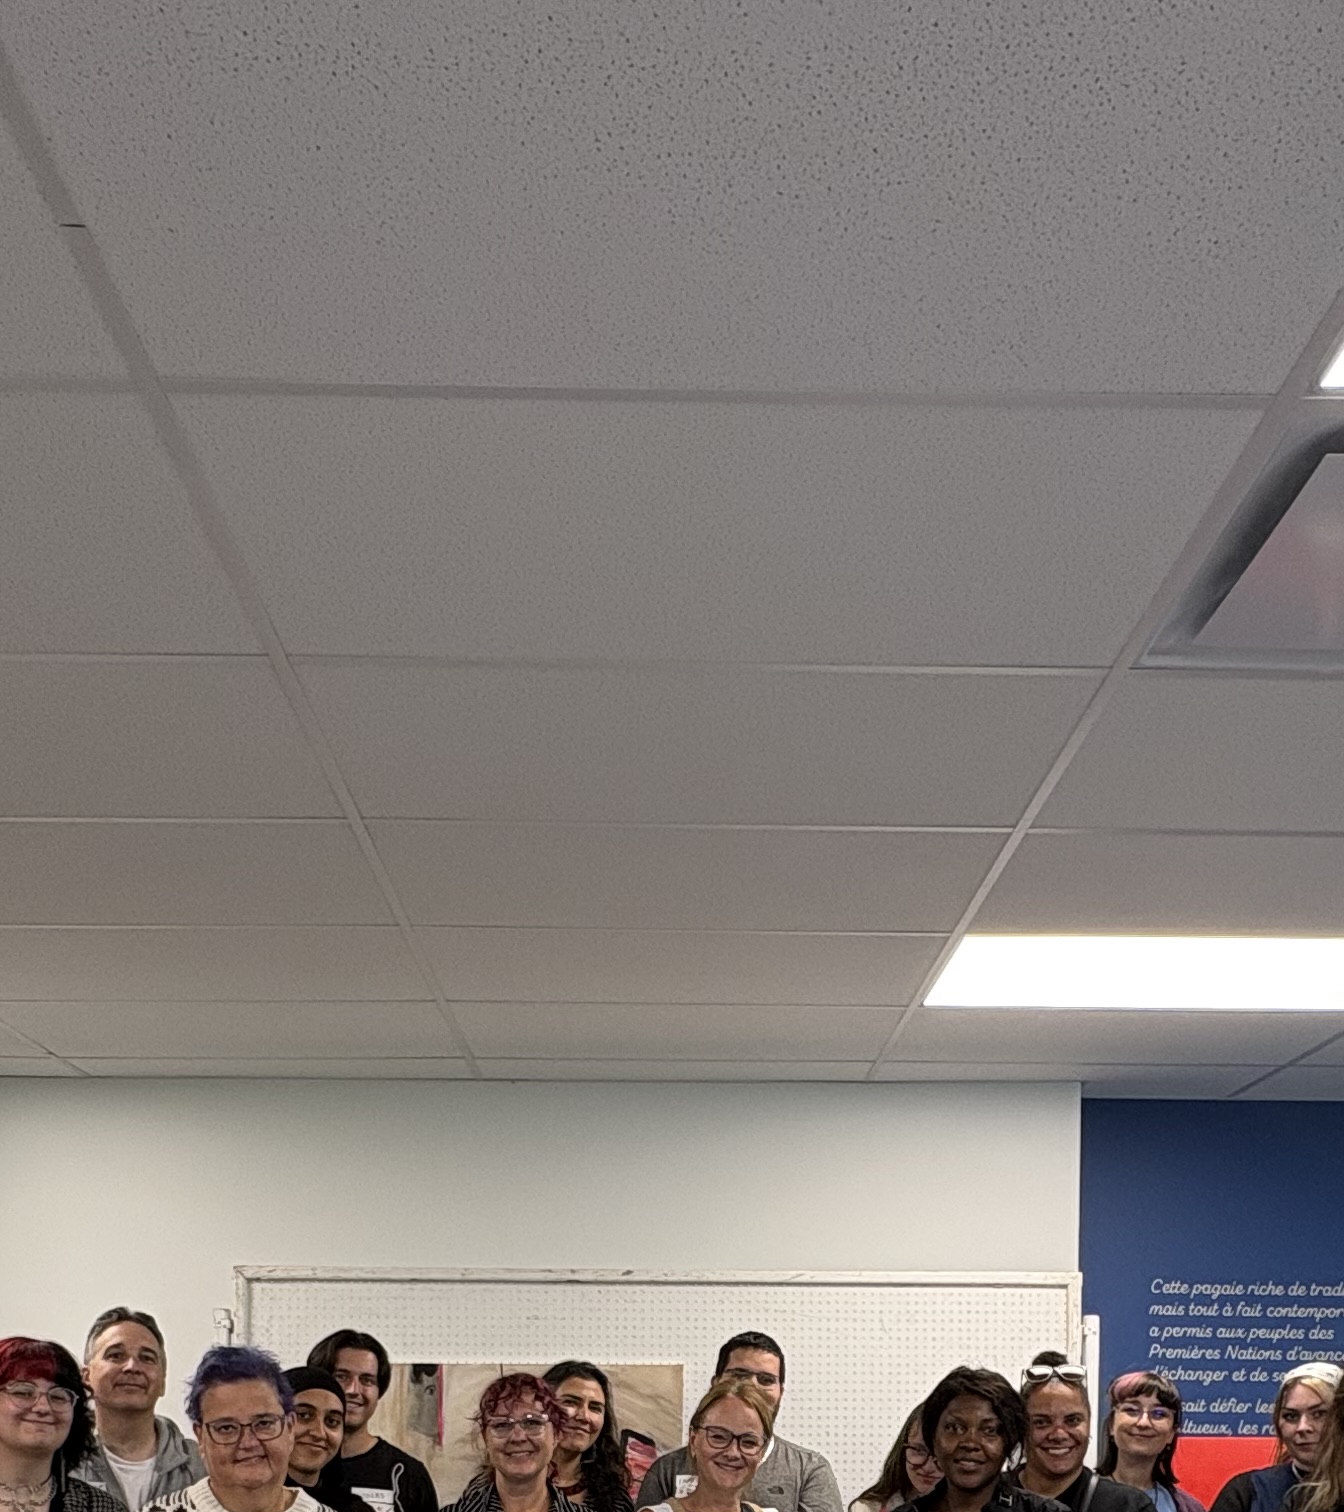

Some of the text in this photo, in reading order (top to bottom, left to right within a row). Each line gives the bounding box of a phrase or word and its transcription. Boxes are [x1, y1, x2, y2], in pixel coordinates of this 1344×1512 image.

[1150, 1278, 1190, 1294] Cette
[1191, 1281, 1246, 1299] pagaie
[1247, 1282, 1286, 1296] riche
[1288, 1282, 1306, 1296] de
[1148, 1302, 1185, 1316] mais
[1189, 1303, 1220, 1317] tout
[1222, 1302, 1234, 1317] à
[1235, 1302, 1263, 1319] fait
[1149, 1324, 1335, 1343] a permis aux peuples des
[1148, 1343, 1221, 1360] Premières
[1223, 1344, 1283, 1361] Nations
[1231, 1368, 1248, 1382] et
[1249, 1367, 1270, 1382] de
[1209, 1398, 1252, 1415] défier
[1255, 1400, 1277, 1415] les
[1237, 1419, 1259, 1435] les
